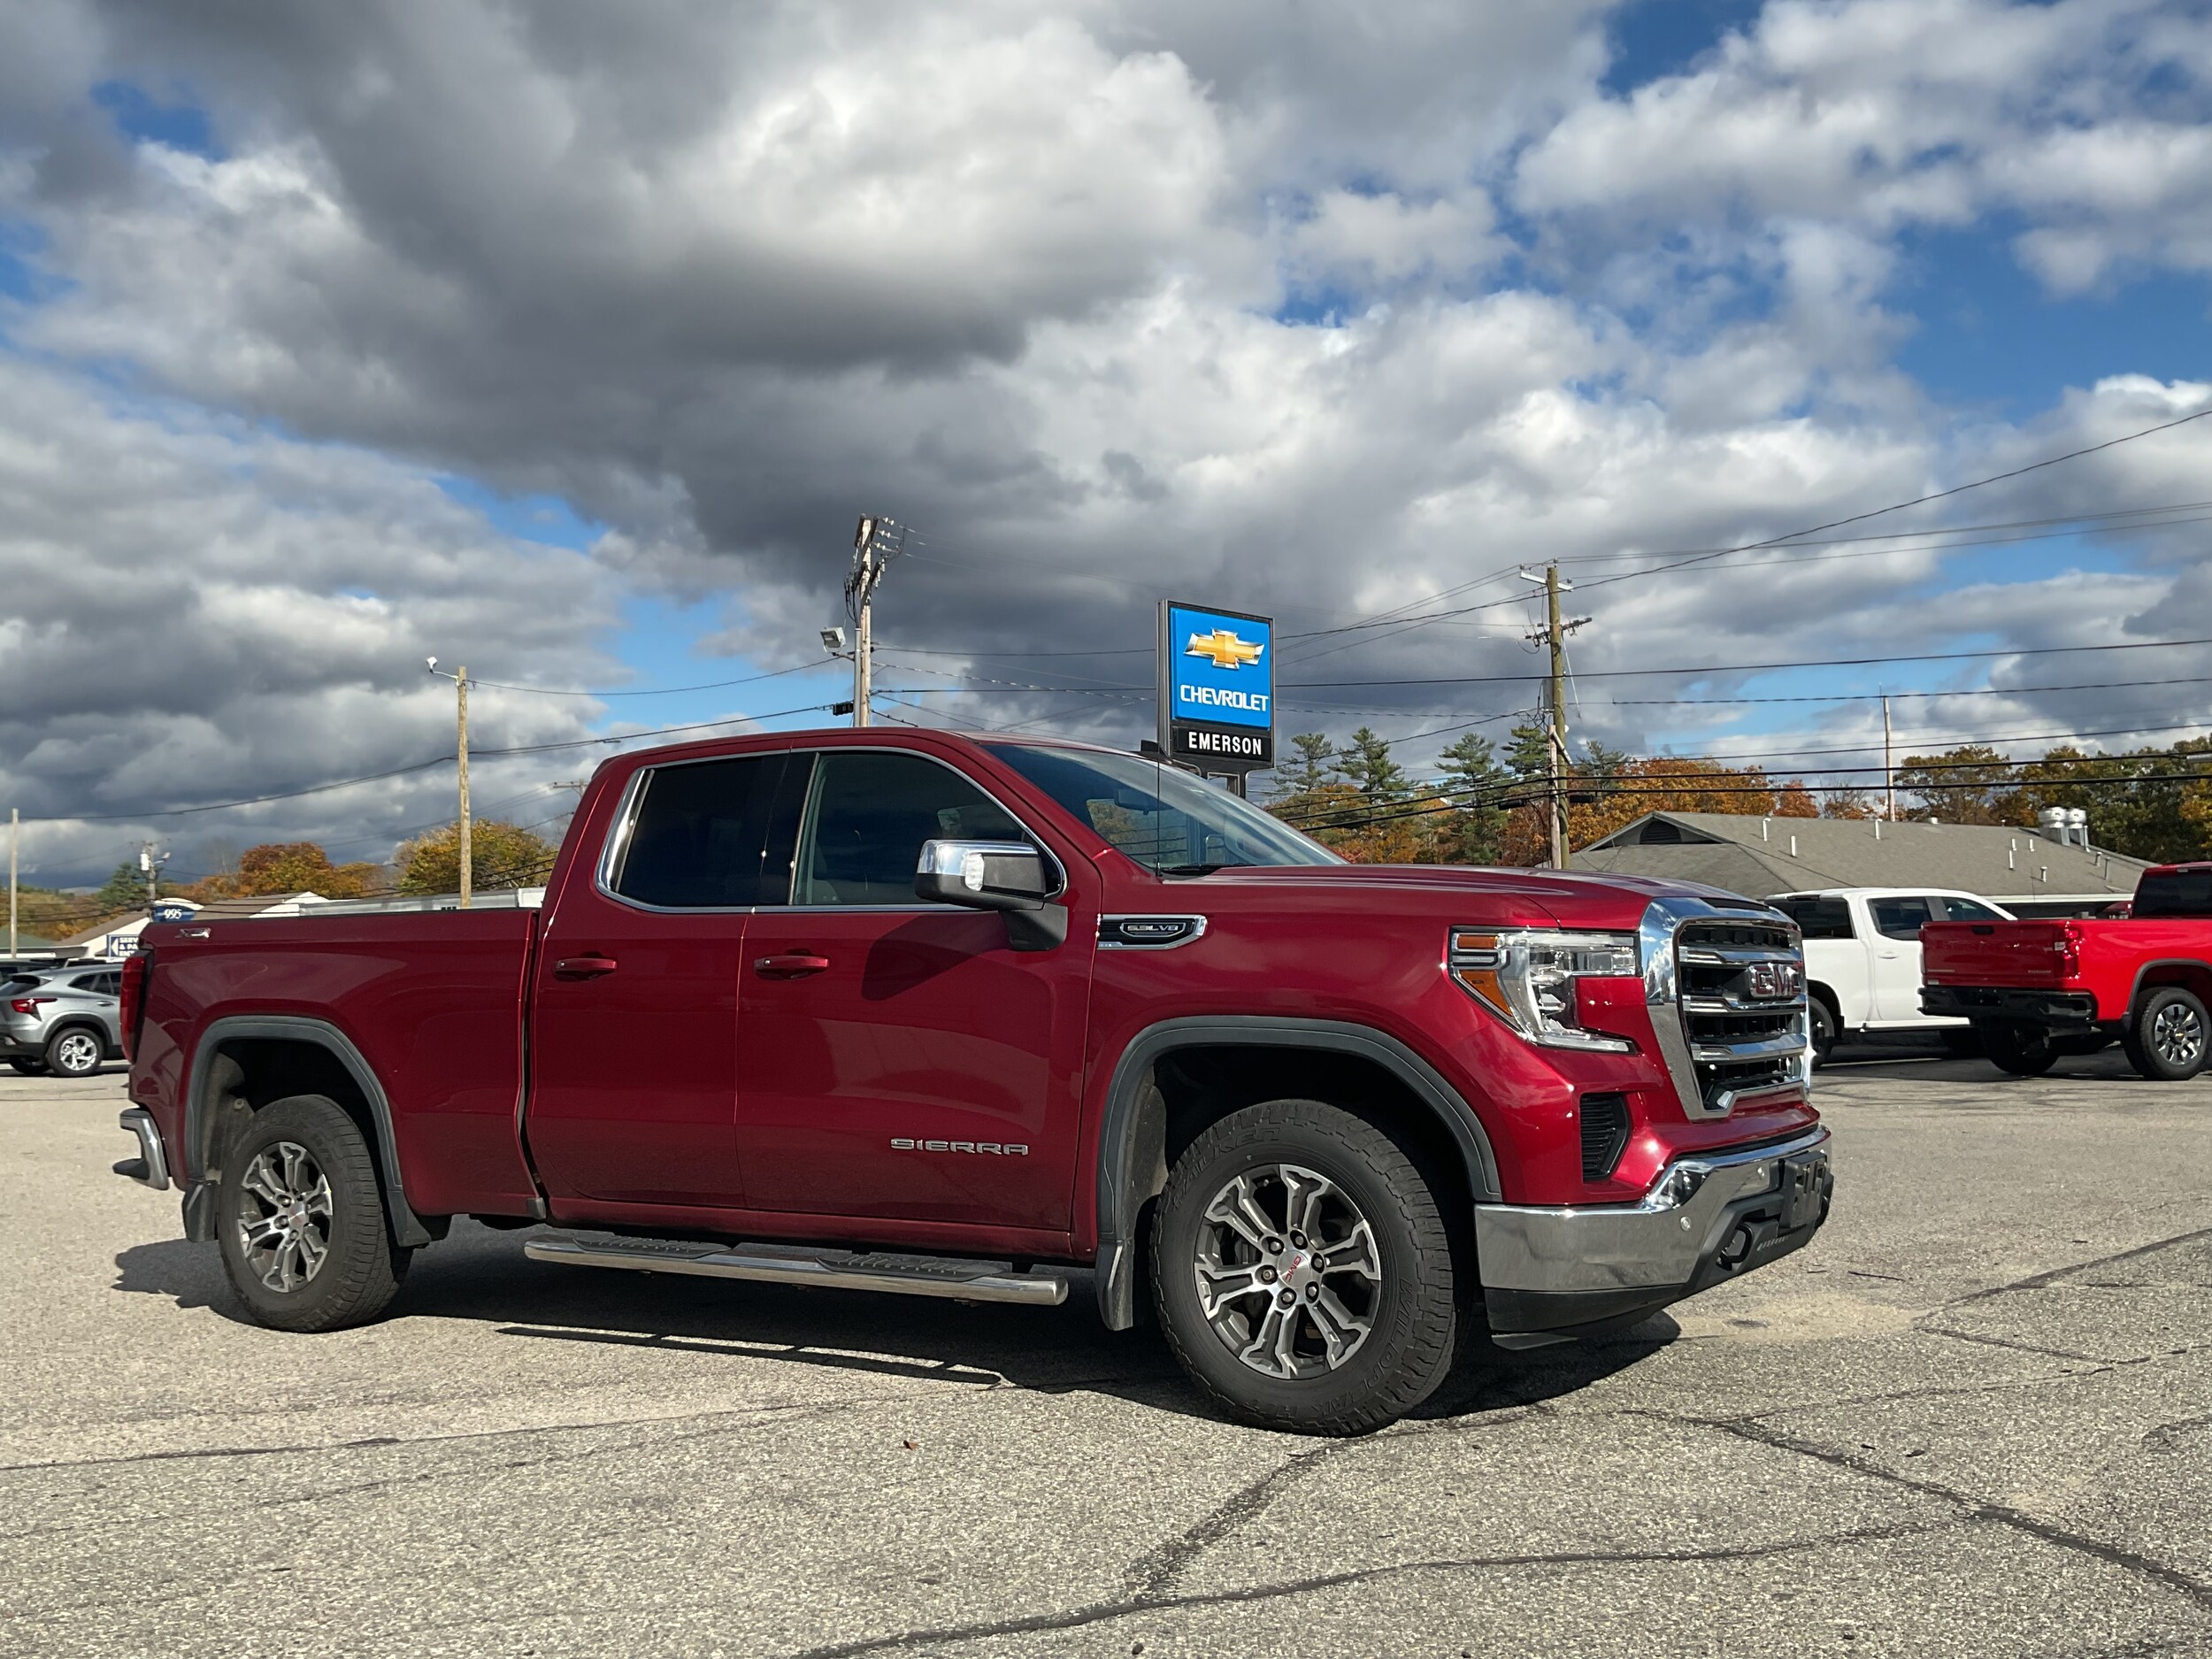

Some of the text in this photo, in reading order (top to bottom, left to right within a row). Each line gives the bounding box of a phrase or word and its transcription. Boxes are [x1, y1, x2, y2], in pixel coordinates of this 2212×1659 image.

[1180, 684, 1269, 711] CHEVROLET
[1188, 731, 1263, 756] EMERSON
[164, 908, 182, 919] 995
[1748, 963, 1801, 998] GMC
[890, 1138, 1029, 1156] SIERRA
[1285, 1256, 1302, 1283] GMC
